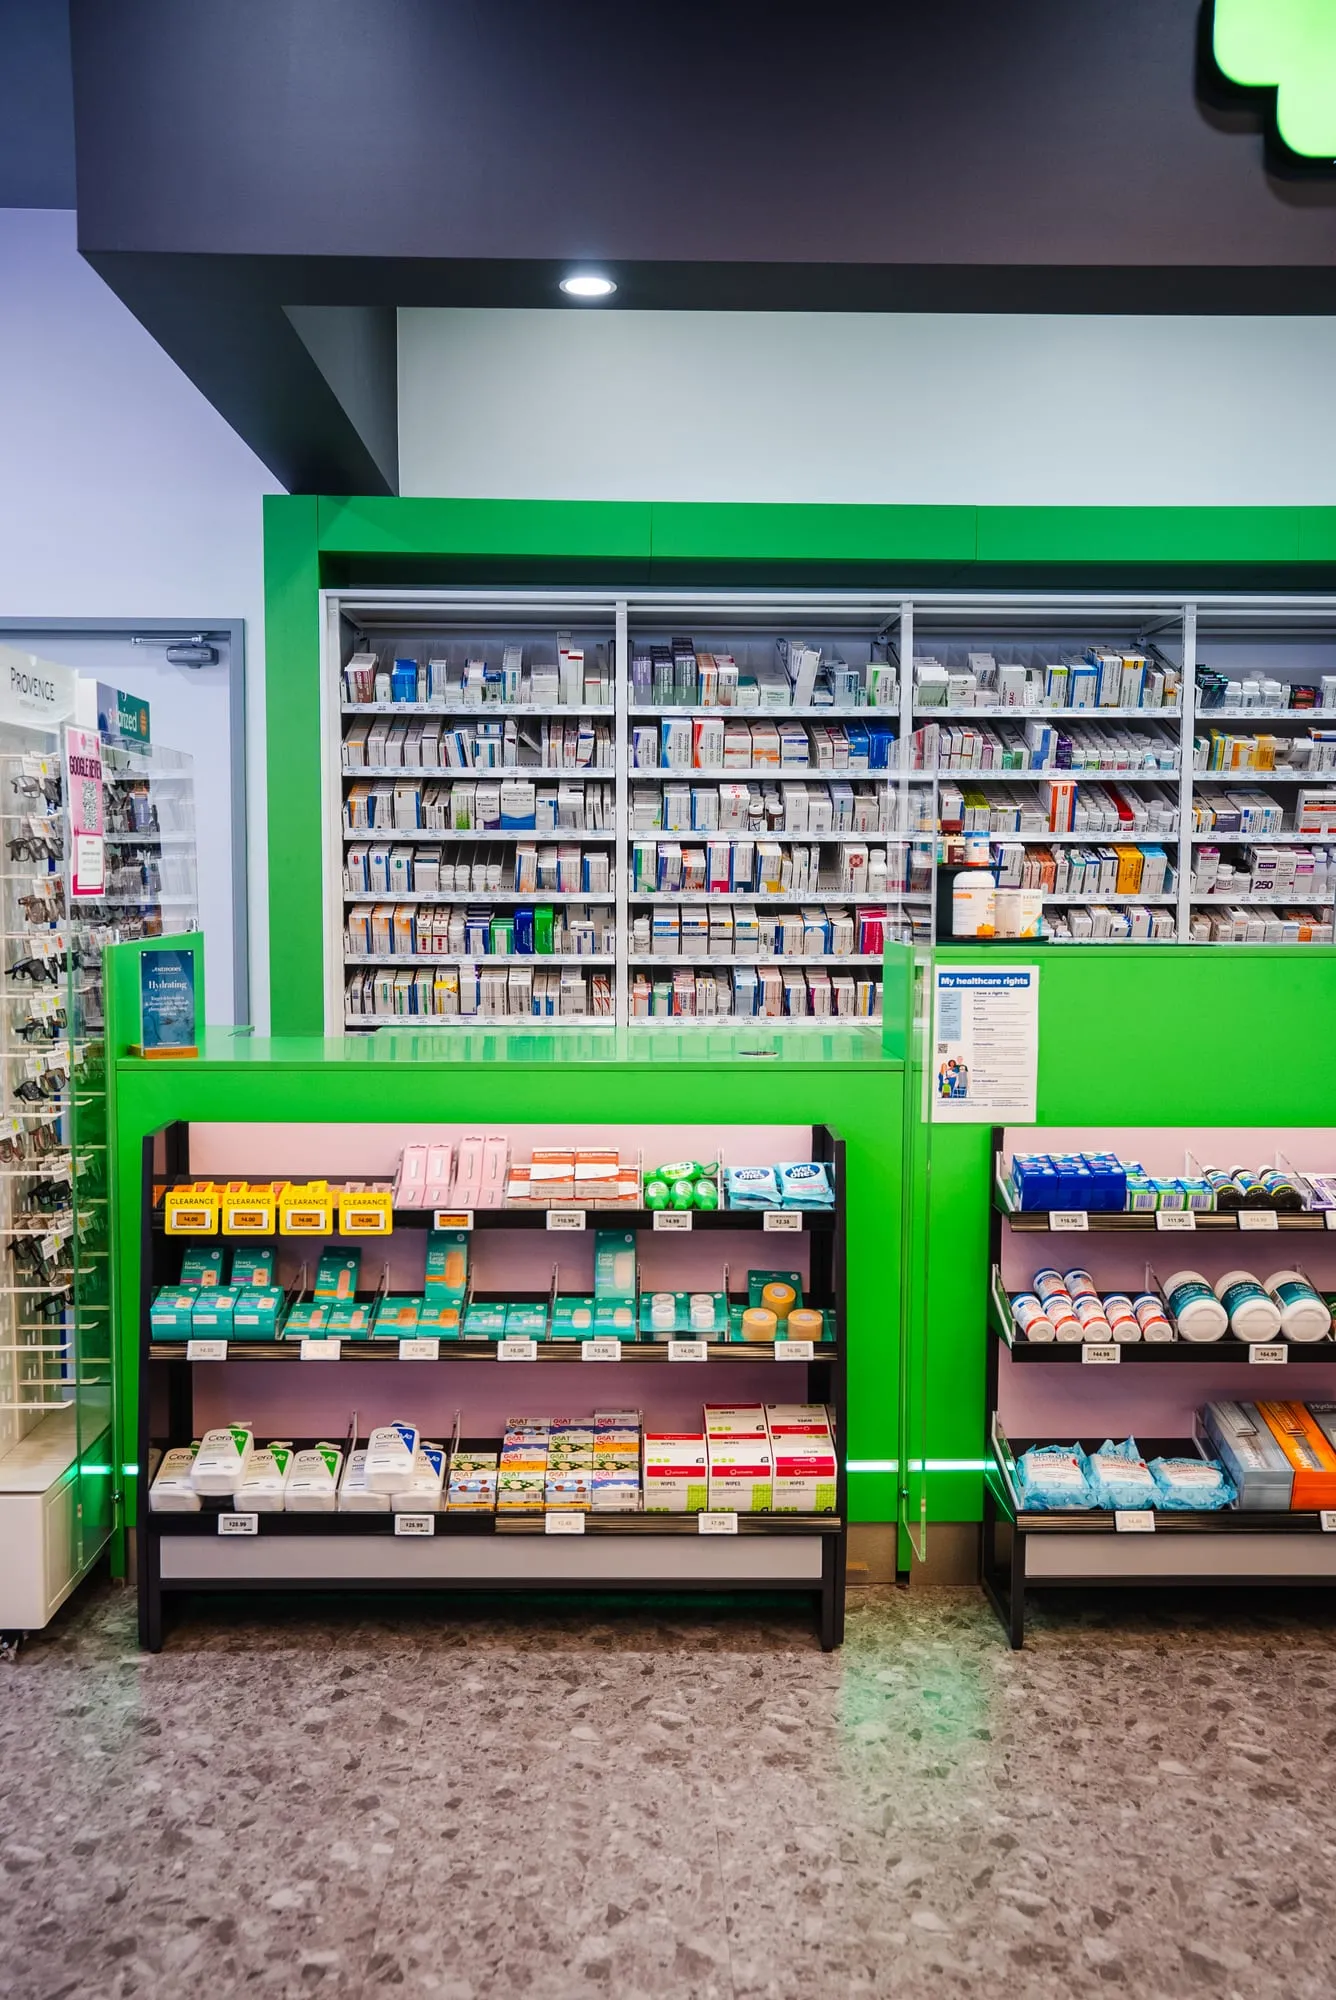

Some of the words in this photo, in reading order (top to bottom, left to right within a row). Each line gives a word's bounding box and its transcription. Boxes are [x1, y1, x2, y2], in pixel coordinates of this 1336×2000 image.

[10, 666, 55, 702] PROVENCE
[70, 755, 89, 778] GOOGLE
[1254, 880, 1274, 890] 250
[148, 980, 188, 991] Hydrating
[940, 977, 954, 986] My
[957, 976, 1002, 985] healthcare
[1003, 977, 1028, 986] rights
